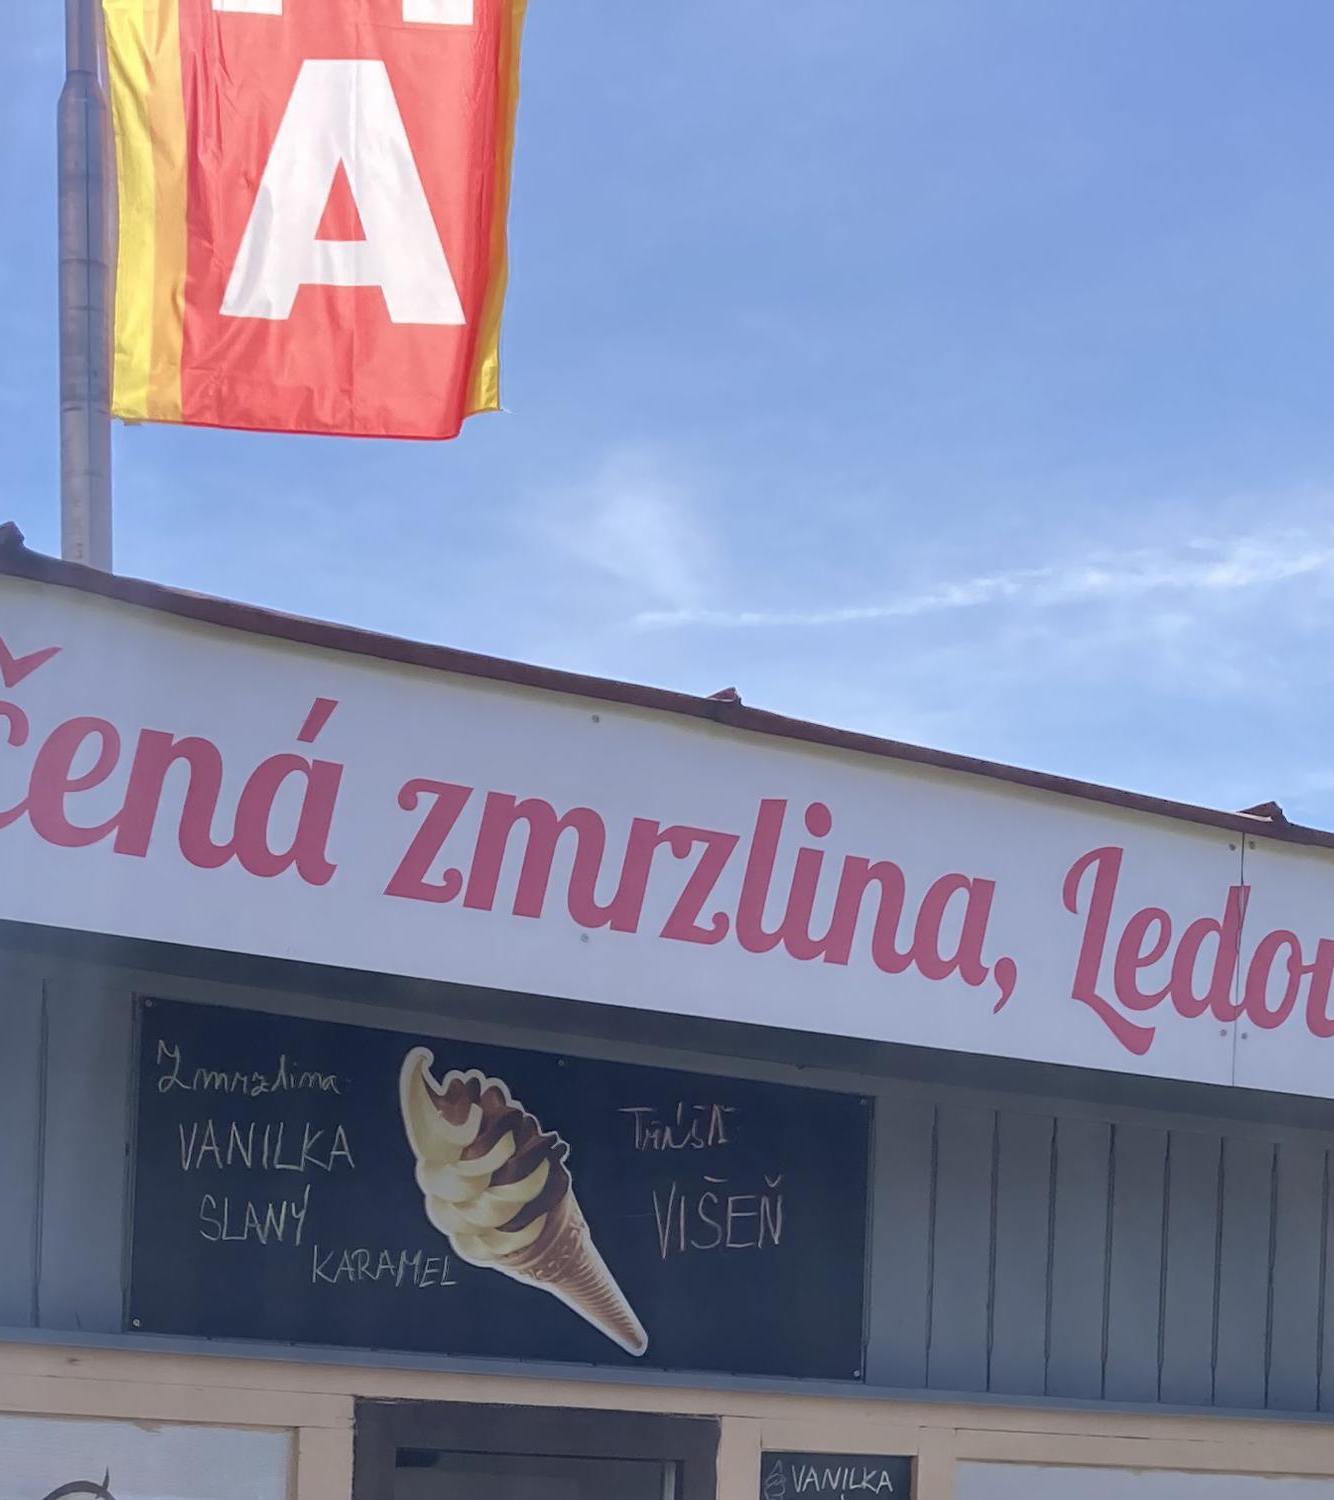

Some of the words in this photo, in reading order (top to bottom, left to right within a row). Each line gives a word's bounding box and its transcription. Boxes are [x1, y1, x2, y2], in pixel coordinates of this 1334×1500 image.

[212, 0, 469, 327] A
[383, 777, 1018, 1015] zmrzlina,
[179, 1119, 355, 1172] VANILKA
[652, 1173, 785, 1260] VIŠEŇ
[312, 1245, 458, 1288] KARAMEL
[791, 1465, 894, 1494] VANILKA
